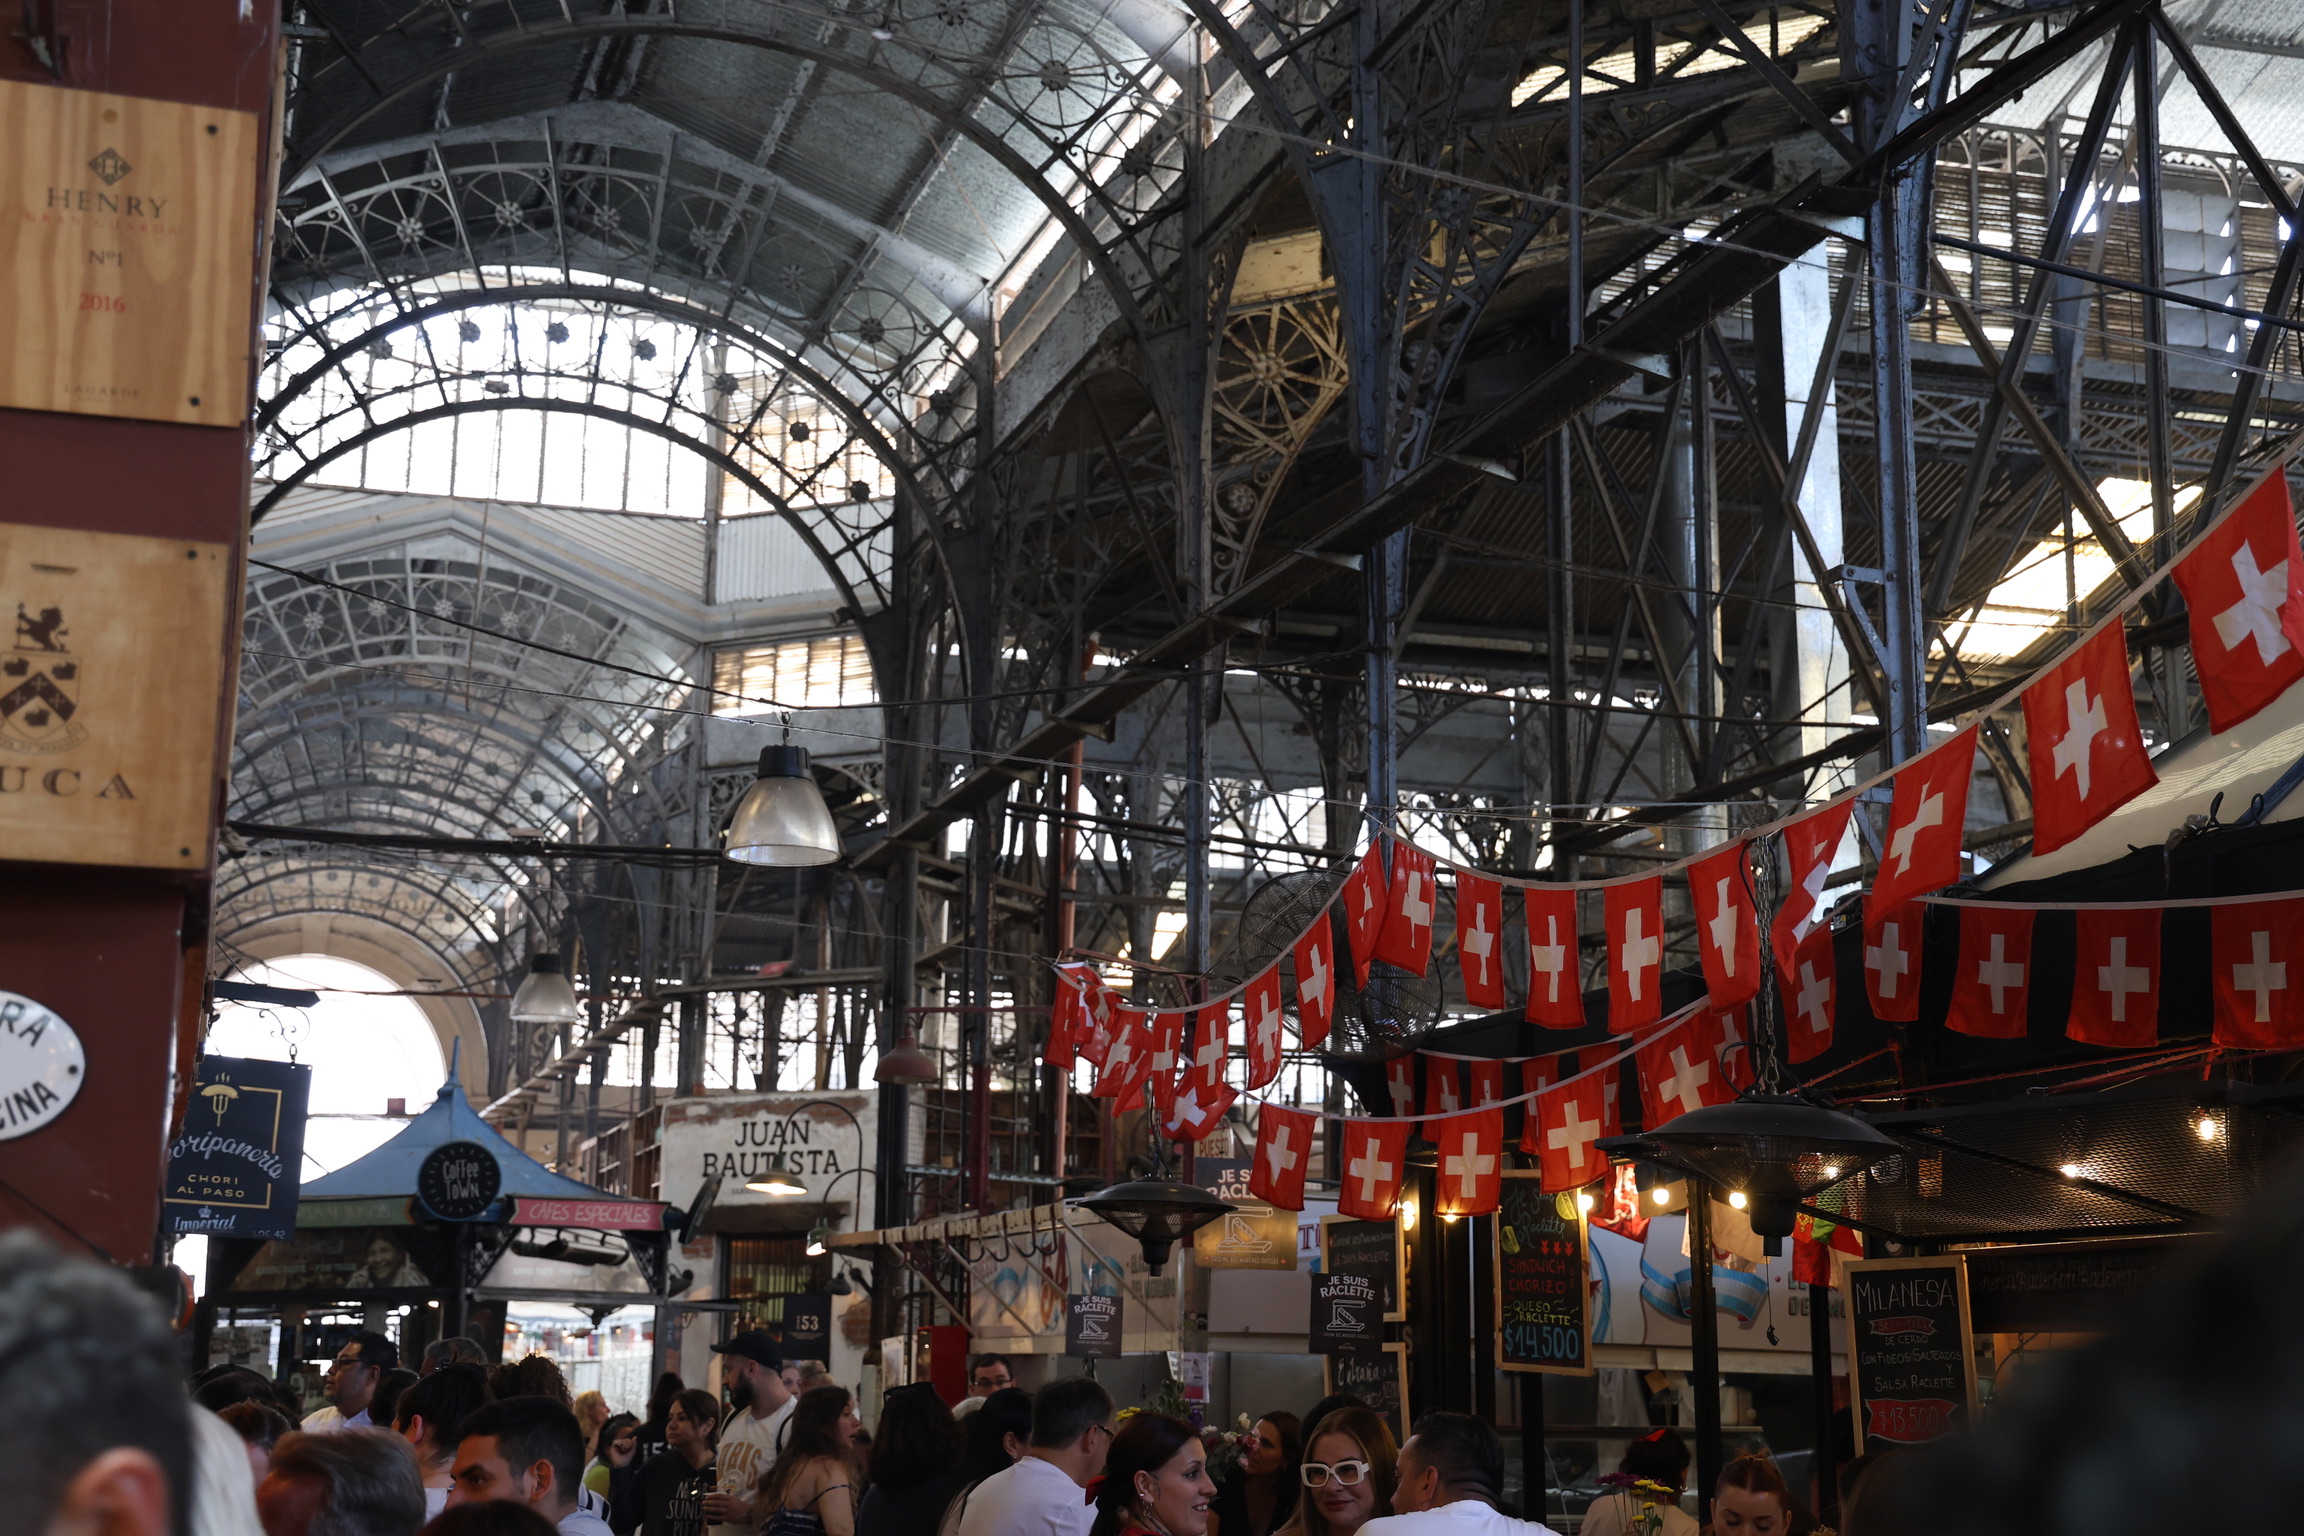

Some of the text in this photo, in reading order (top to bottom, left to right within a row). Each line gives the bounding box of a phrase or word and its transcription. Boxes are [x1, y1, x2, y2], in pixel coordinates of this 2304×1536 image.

[47, 186, 168, 219] HENRY
[25, 212, 179, 235] GRAN GUARDA
[79, 292, 127, 313] 2016
[734, 1120, 811, 1147] JUAN
[701, 1149, 842, 1178] BAUTSTA
[187, 1173, 239, 1186] CHORI
[1217, 1169, 1236, 1184] JE
[176, 1185, 246, 1198] AL PASO
[529, 1202, 652, 1225] CAFES ESPECIALES
[174, 1214, 237, 1232] Imperial
[273, 1229, 286, 1239] 42
[1507, 1258, 1567, 1275] SANDWICH
[1328, 1275, 1370, 1288] JE SUIS
[1508, 1278, 1567, 1294] CHORIZO
[1080, 1295, 1112, 1305] JE SUIS
[1319, 1285, 1376, 1301] RACLETTE
[1855, 1278, 1956, 1315] MILANESA
[1073, 1303, 1117, 1315] RACLETTE
[1512, 1299, 1551, 1313] QUESO
[801, 1315, 819, 1332] 53
[1519, 1311, 1571, 1326] RACLETTE
[1885, 1334, 1929, 1346] DE CERDO
[1877, 1351, 1911, 1364] FIDEOS
[1946, 1363, 1953, 1374] Y
[1874, 1374, 1955, 1392] SALSA RACLETTE
